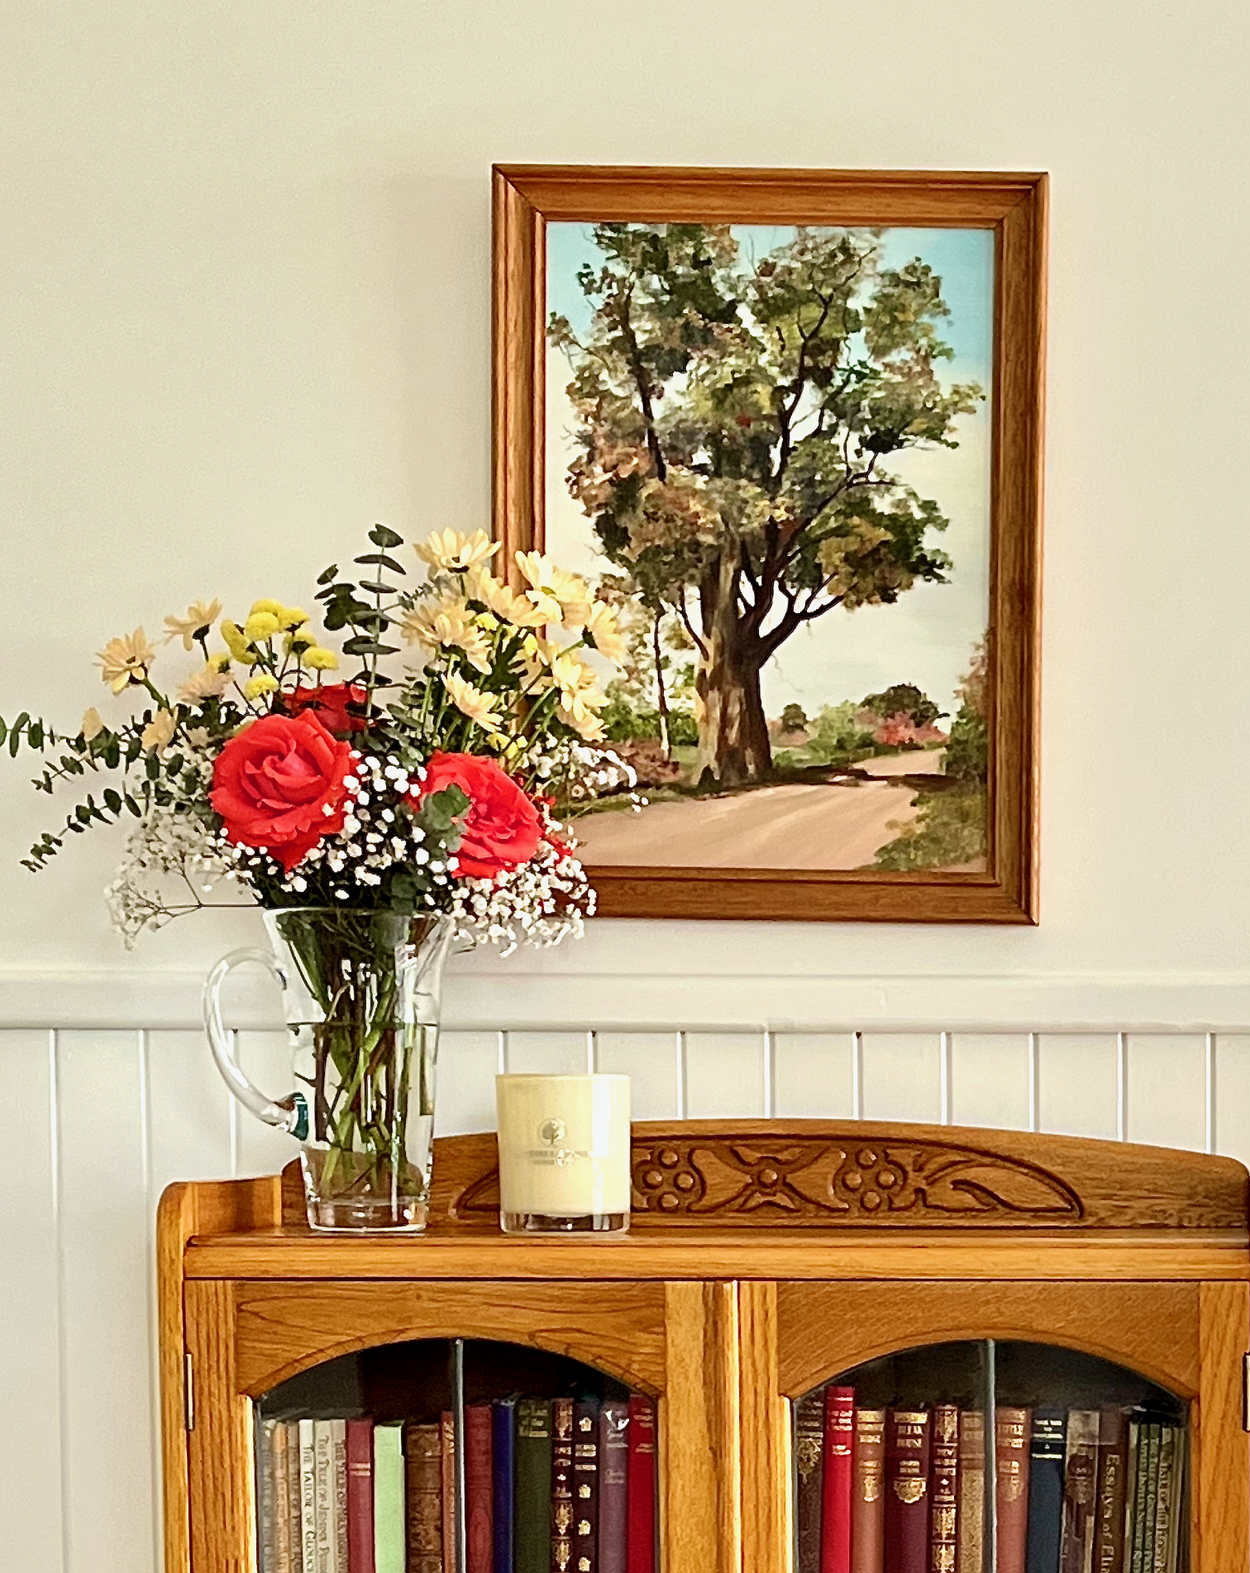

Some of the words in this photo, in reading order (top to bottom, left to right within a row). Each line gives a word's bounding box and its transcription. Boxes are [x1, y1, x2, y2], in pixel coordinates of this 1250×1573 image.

[303, 1467, 315, 1508] TAILOR
[1100, 1453, 1120, 1519] Essays
[1101, 1523, 1113, 1538] of
